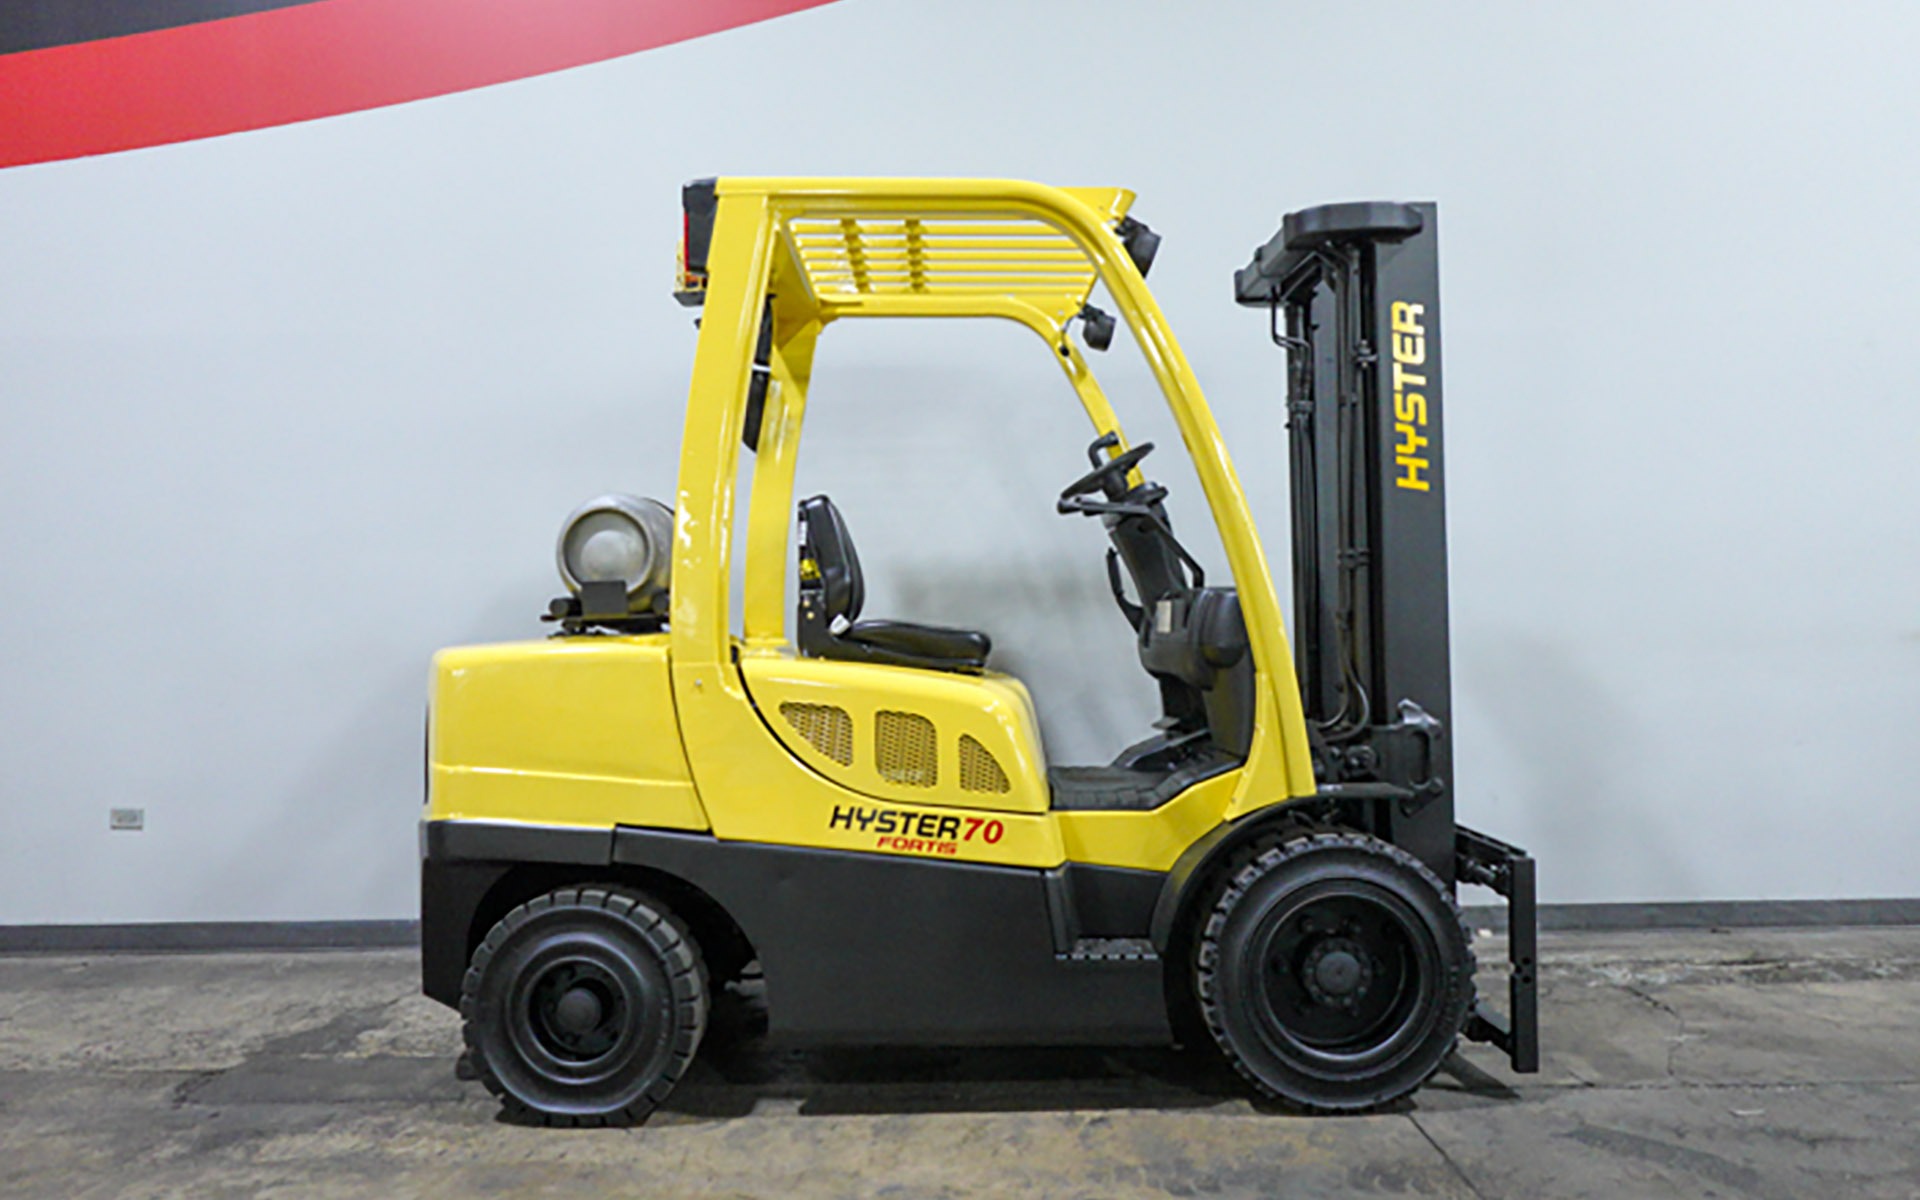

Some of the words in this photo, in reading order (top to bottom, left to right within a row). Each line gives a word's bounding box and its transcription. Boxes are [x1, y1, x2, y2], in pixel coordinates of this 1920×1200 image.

[1391, 301, 1430, 492] HYSTER
[829, 805, 961, 840] HYSTER
[963, 817, 1004, 844] 70
[877, 836, 958, 855] FORTIS
